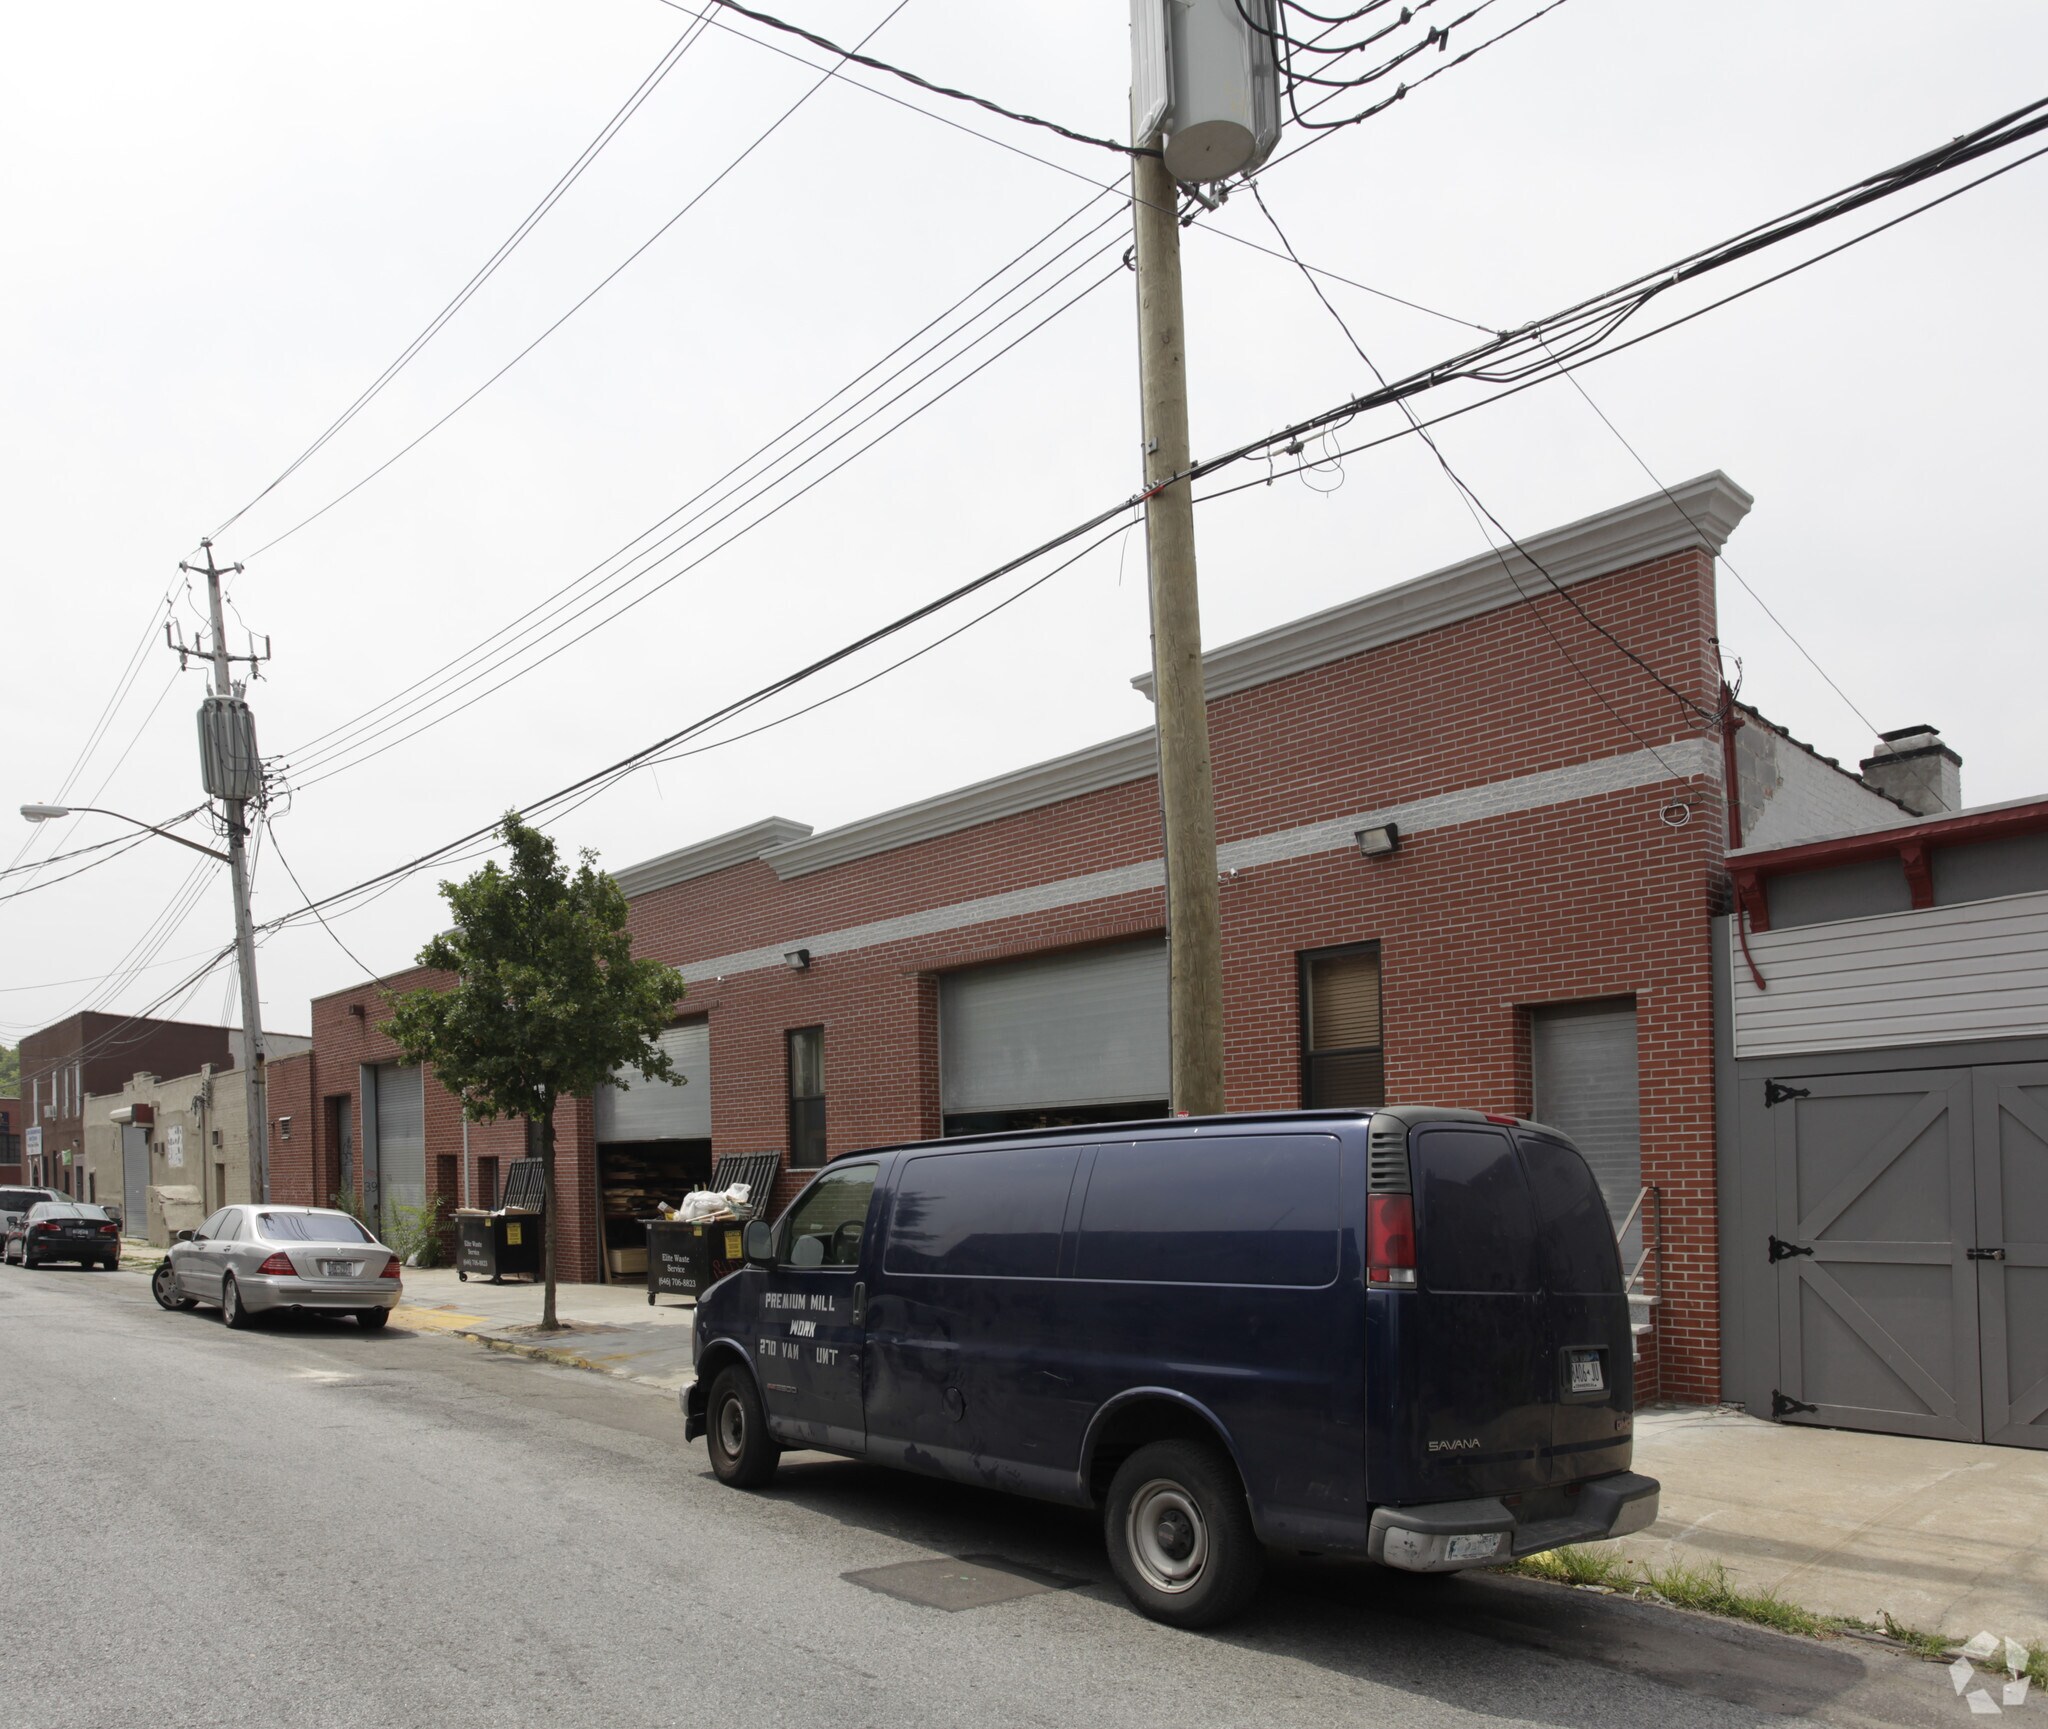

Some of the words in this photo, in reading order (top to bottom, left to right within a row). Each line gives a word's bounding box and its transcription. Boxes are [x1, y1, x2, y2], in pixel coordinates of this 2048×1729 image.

[662, 1253, 673, 1262] Elite
[674, 1254, 690, 1263] Waste
[667, 1264, 685, 1274] Service
[658, 1277, 671, 1287] (646)
[672, 1278, 696, 1288] 706-8823
[765, 1293, 806, 1310] PREMIUM
[810, 1294, 835, 1312] MILL
[789, 1319, 817, 1338] WORK
[1428, 1438, 1481, 1451] SAVANA
